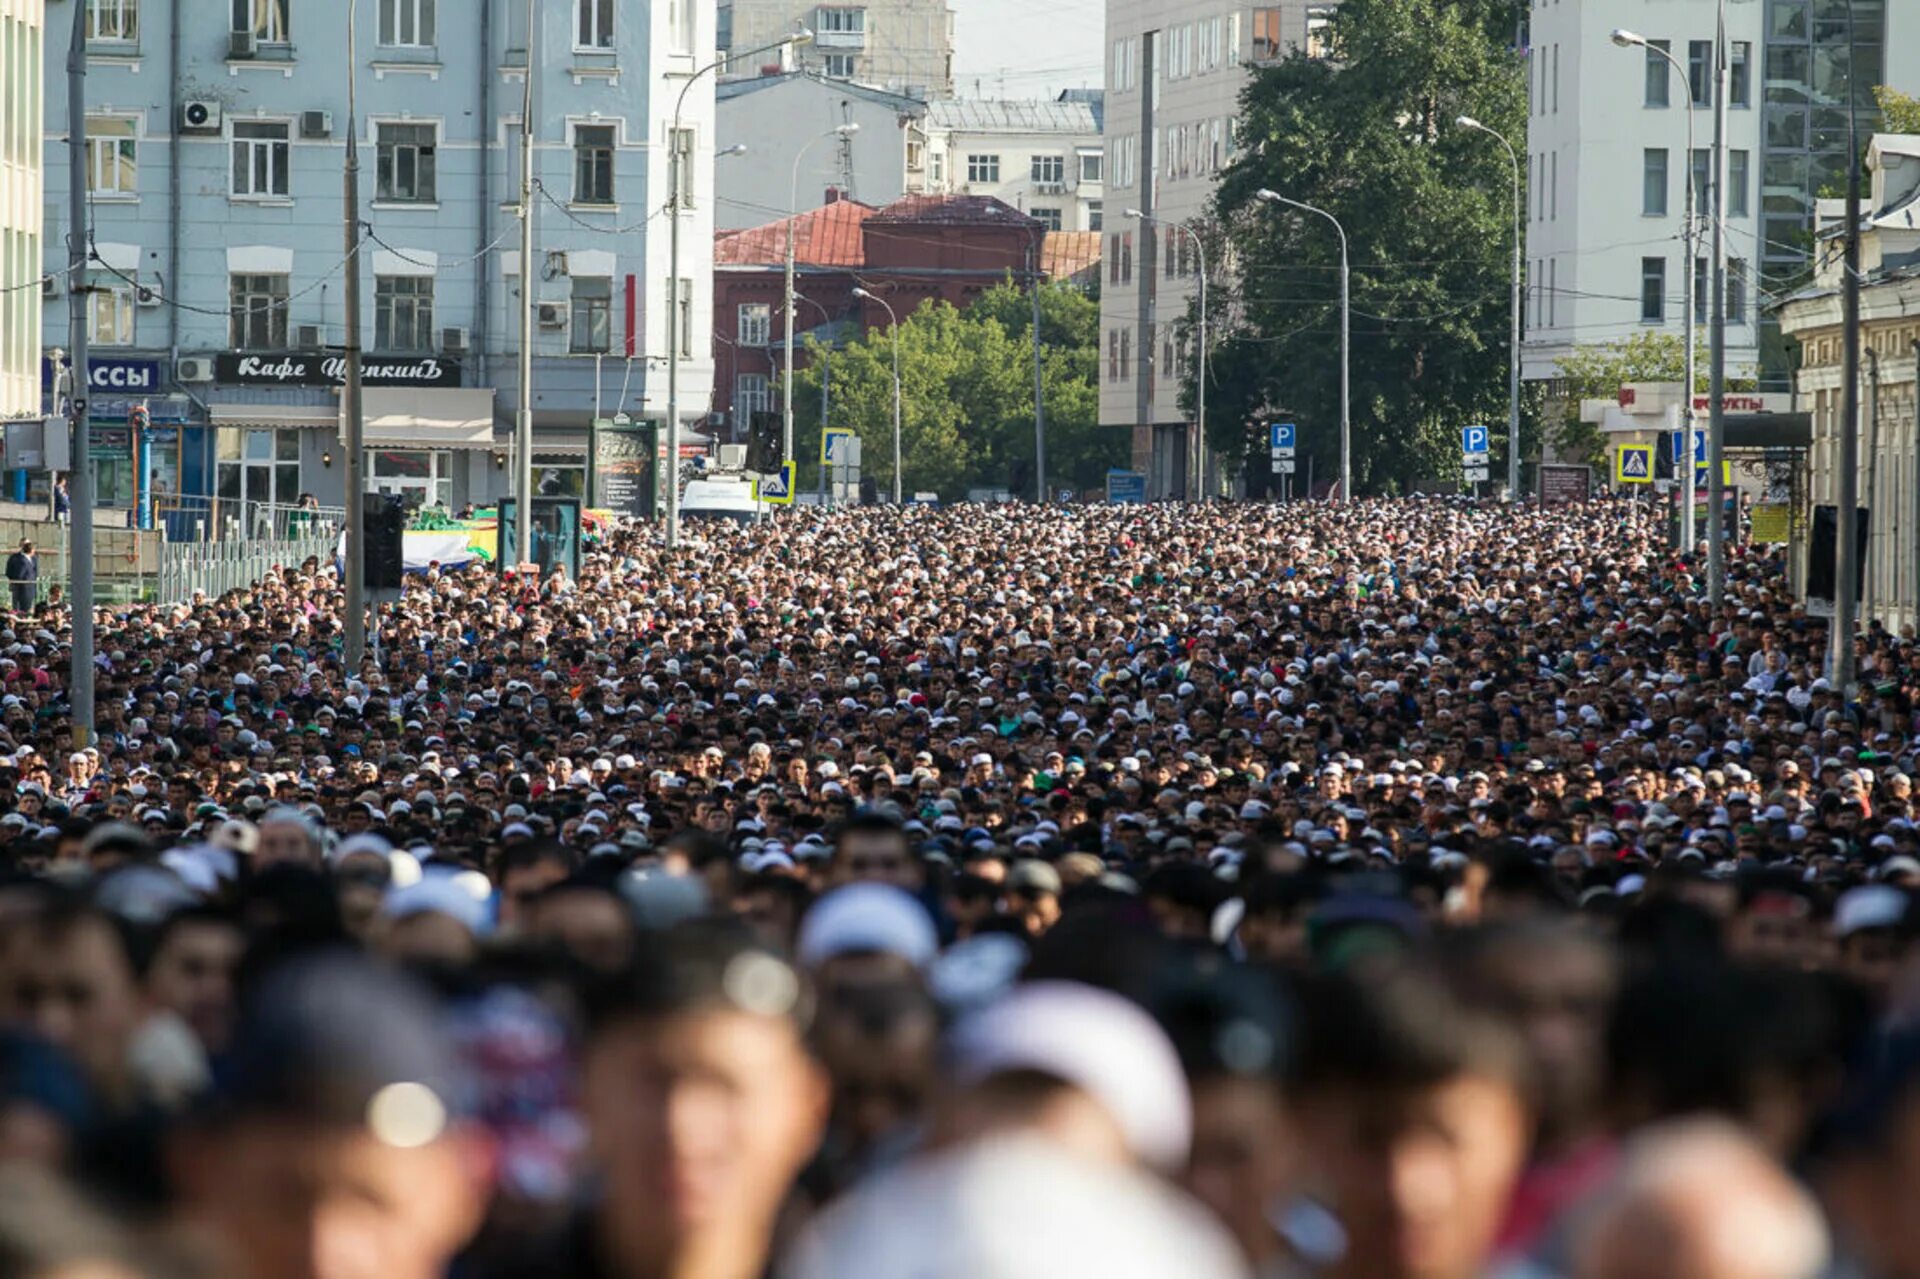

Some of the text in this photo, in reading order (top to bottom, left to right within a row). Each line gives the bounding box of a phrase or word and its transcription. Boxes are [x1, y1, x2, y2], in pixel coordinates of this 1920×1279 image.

[80, 366, 150, 386] ССЫ
[238, 357, 305, 380] Кафе
[1693, 398, 1763, 411] РОУКТЫ
[1277, 427, 1290, 444] P
[1469, 429, 1483, 450] P
